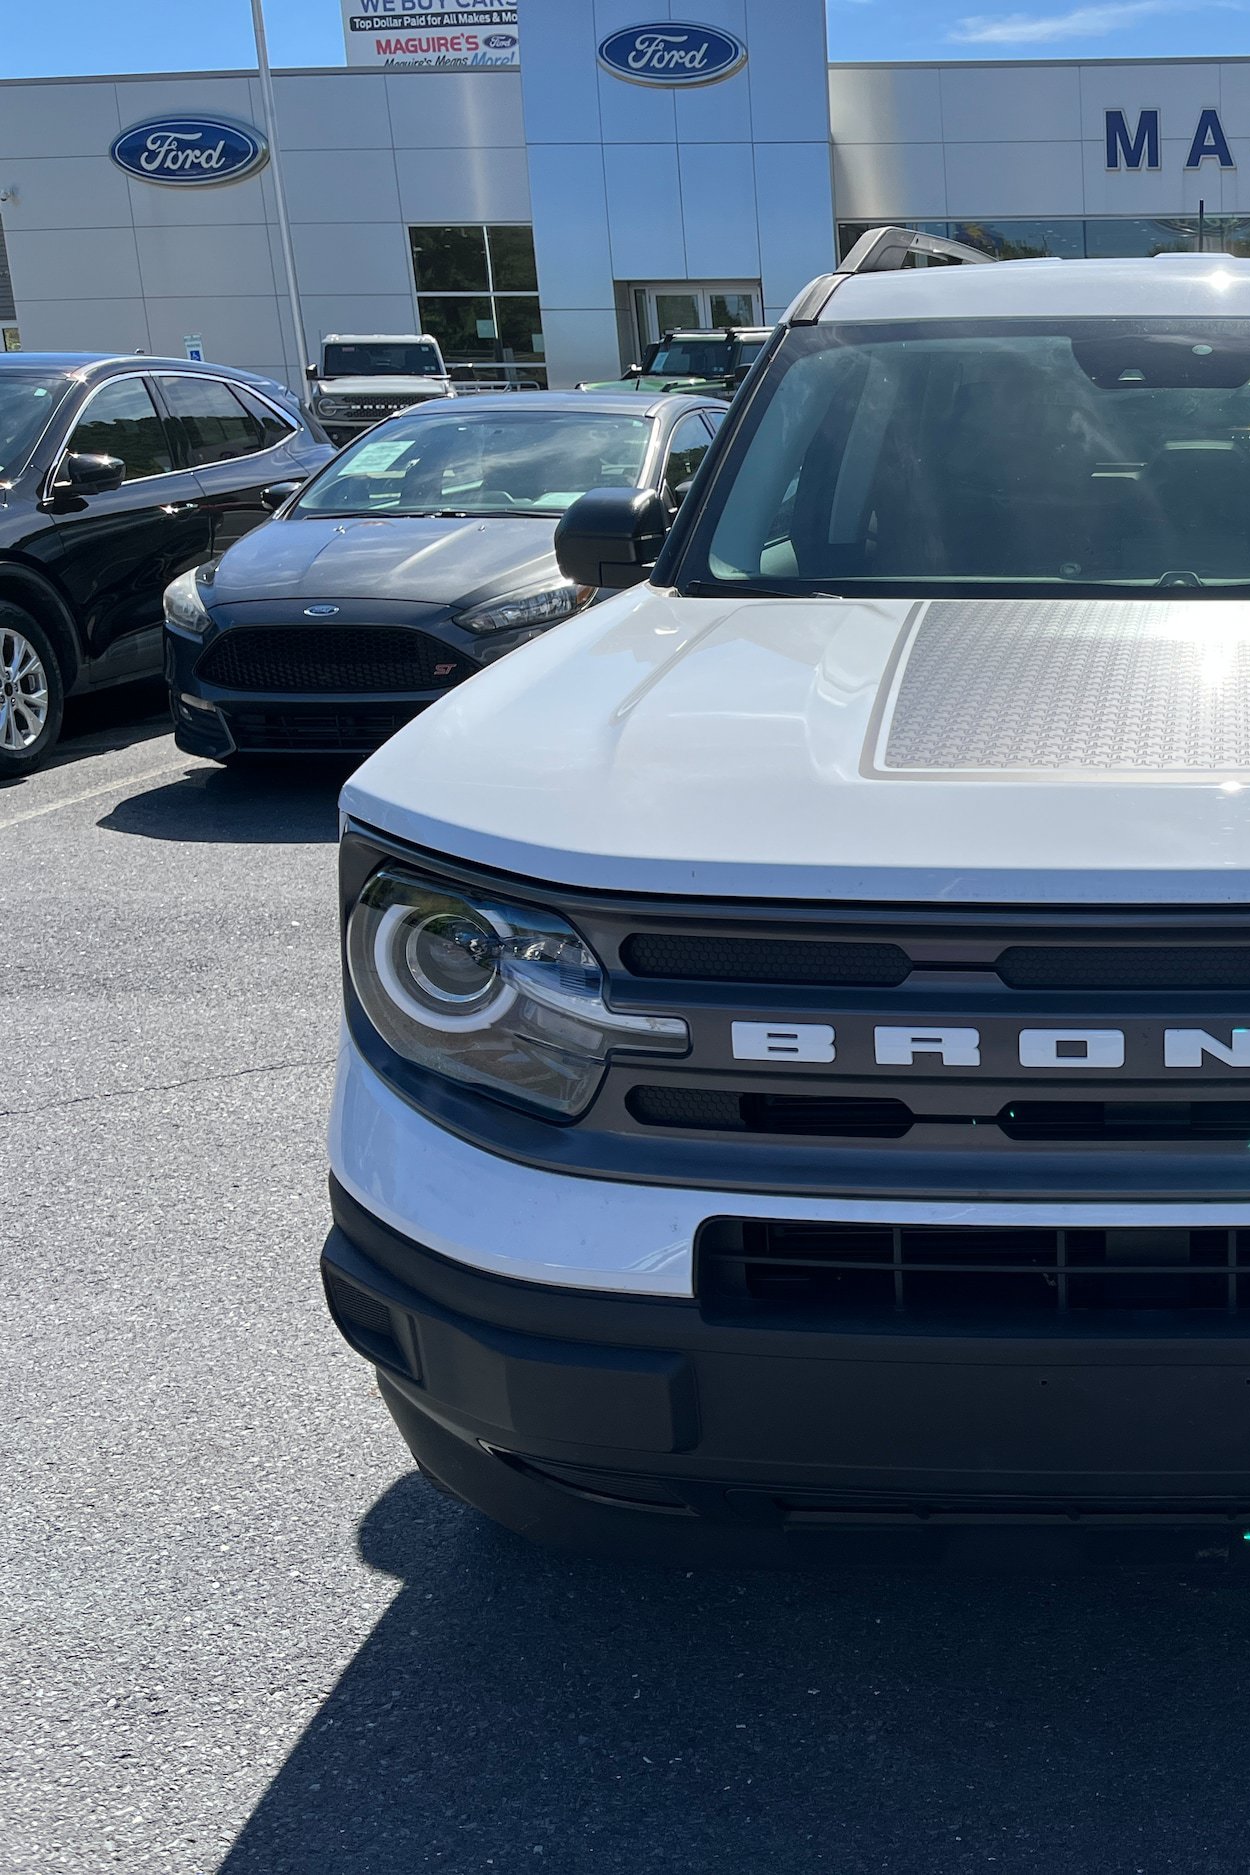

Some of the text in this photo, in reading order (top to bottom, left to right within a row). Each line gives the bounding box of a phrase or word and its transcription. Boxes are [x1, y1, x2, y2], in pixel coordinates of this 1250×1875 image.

[353, 19, 372, 30] Top
[373, 17, 402, 28] Dollar
[403, 15, 426, 26] Paid
[427, 14, 441, 25] for
[443, 13, 457, 25] All
[459, 12, 491, 24] Makes
[492, 12, 501, 22] &
[375, 33, 479, 55] MAGUIRE'S
[489, 36, 512, 47] Ford
[435, 55, 468, 66] Means
[471, 51, 515, 66] More!
[627, 34, 709, 69] Ford
[140, 132, 226, 171] Ford
[433, 663, 457, 675] ST
